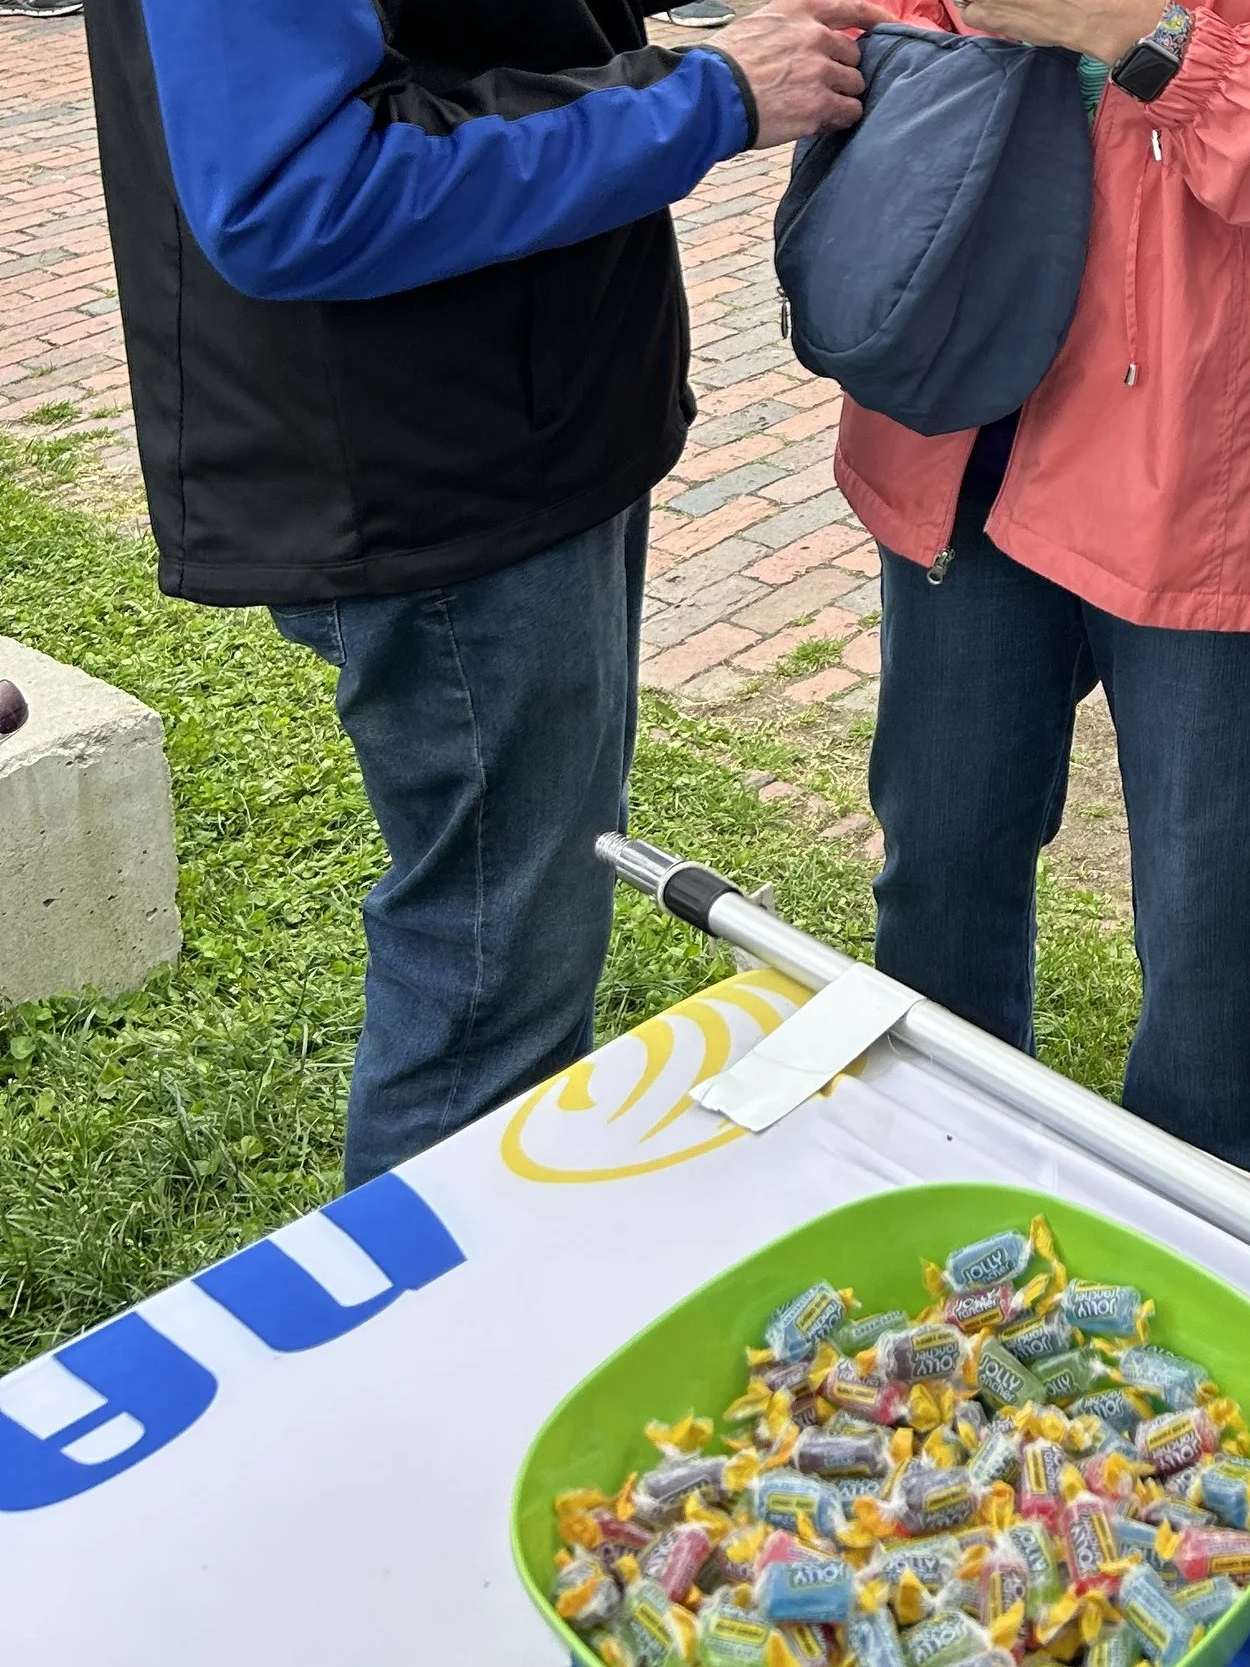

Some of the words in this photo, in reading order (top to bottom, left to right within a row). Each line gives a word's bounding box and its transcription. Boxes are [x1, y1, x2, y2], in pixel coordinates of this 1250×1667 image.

[963, 1248, 1008, 1280] JOLLY
[1077, 1298, 1117, 1319] JOLLY
[916, 1353, 957, 1376] JOLLY
[980, 1356, 1022, 1391] JOLLY
[1045, 1377, 1071, 1397] OLLY
[1157, 1441, 1199, 1472] JOLLY
[793, 1563, 846, 1585] JOLLY
